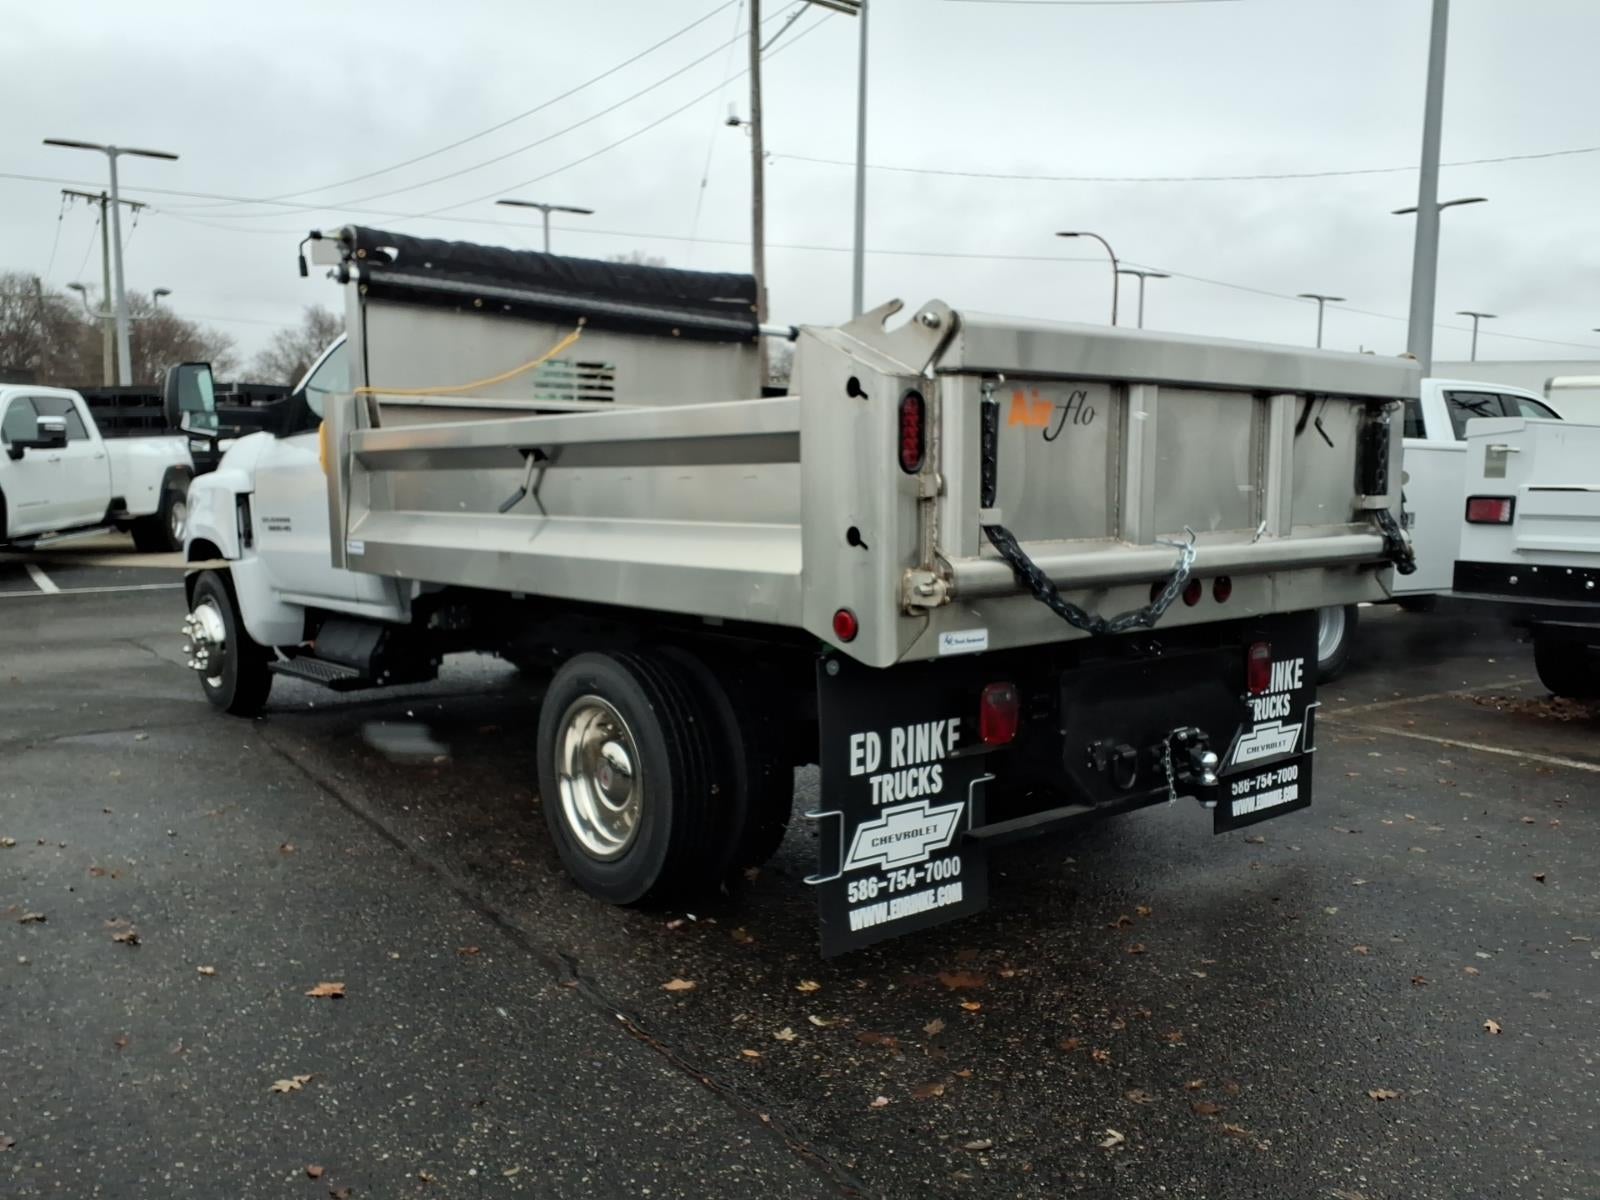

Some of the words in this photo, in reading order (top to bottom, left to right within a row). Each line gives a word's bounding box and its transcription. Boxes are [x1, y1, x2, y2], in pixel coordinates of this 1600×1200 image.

[1260, 658, 1304, 695] INKE
[850, 731, 882, 777] ED
[890, 717, 961, 768] RINKE
[1246, 740, 1287, 755] CHEVROLET
[869, 764, 943, 805] TRUCKS
[1231, 765, 1298, 796] 586-754-7000
[871, 824, 938, 848] CHEVROLET
[847, 856, 961, 903] 586-754-7000
